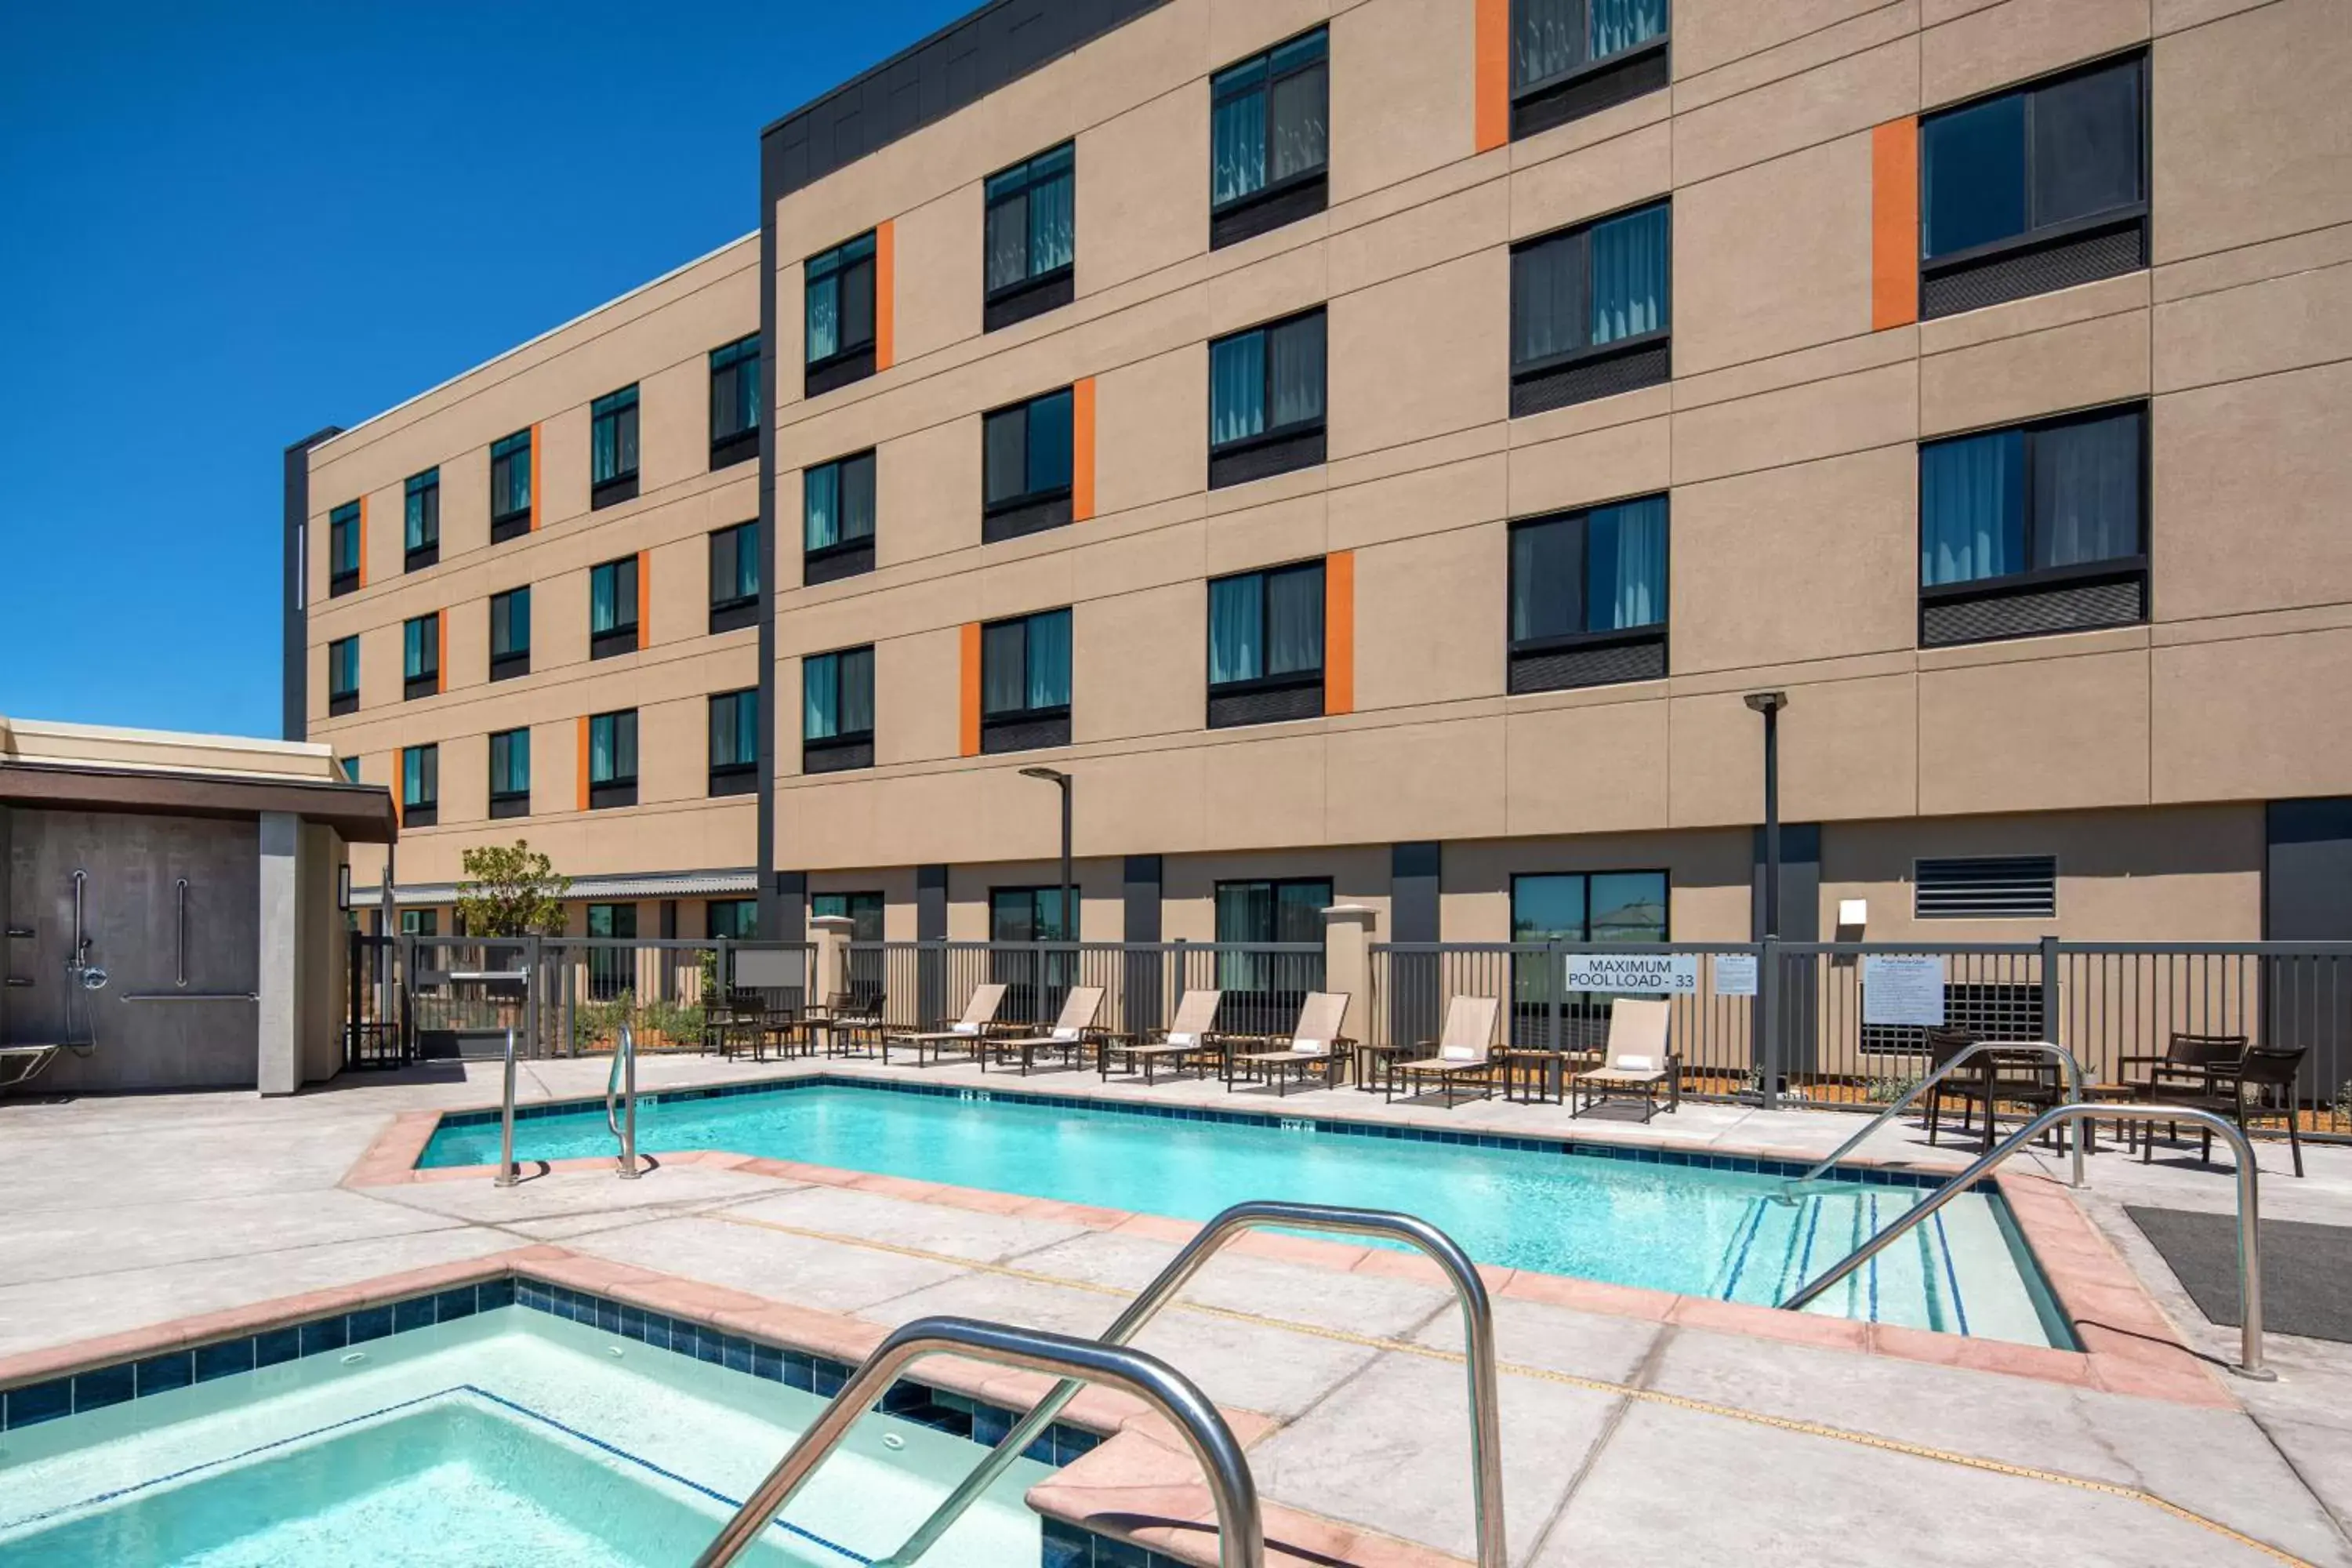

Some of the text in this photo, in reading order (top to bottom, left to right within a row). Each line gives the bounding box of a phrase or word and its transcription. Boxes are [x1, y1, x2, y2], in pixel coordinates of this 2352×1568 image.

[1589, 960, 1671, 973] MAXIMUM
[1569, 974, 1614, 985] POOL
[1616, 974, 1661, 987] LOAD
[1675, 975, 1694, 988] 33
